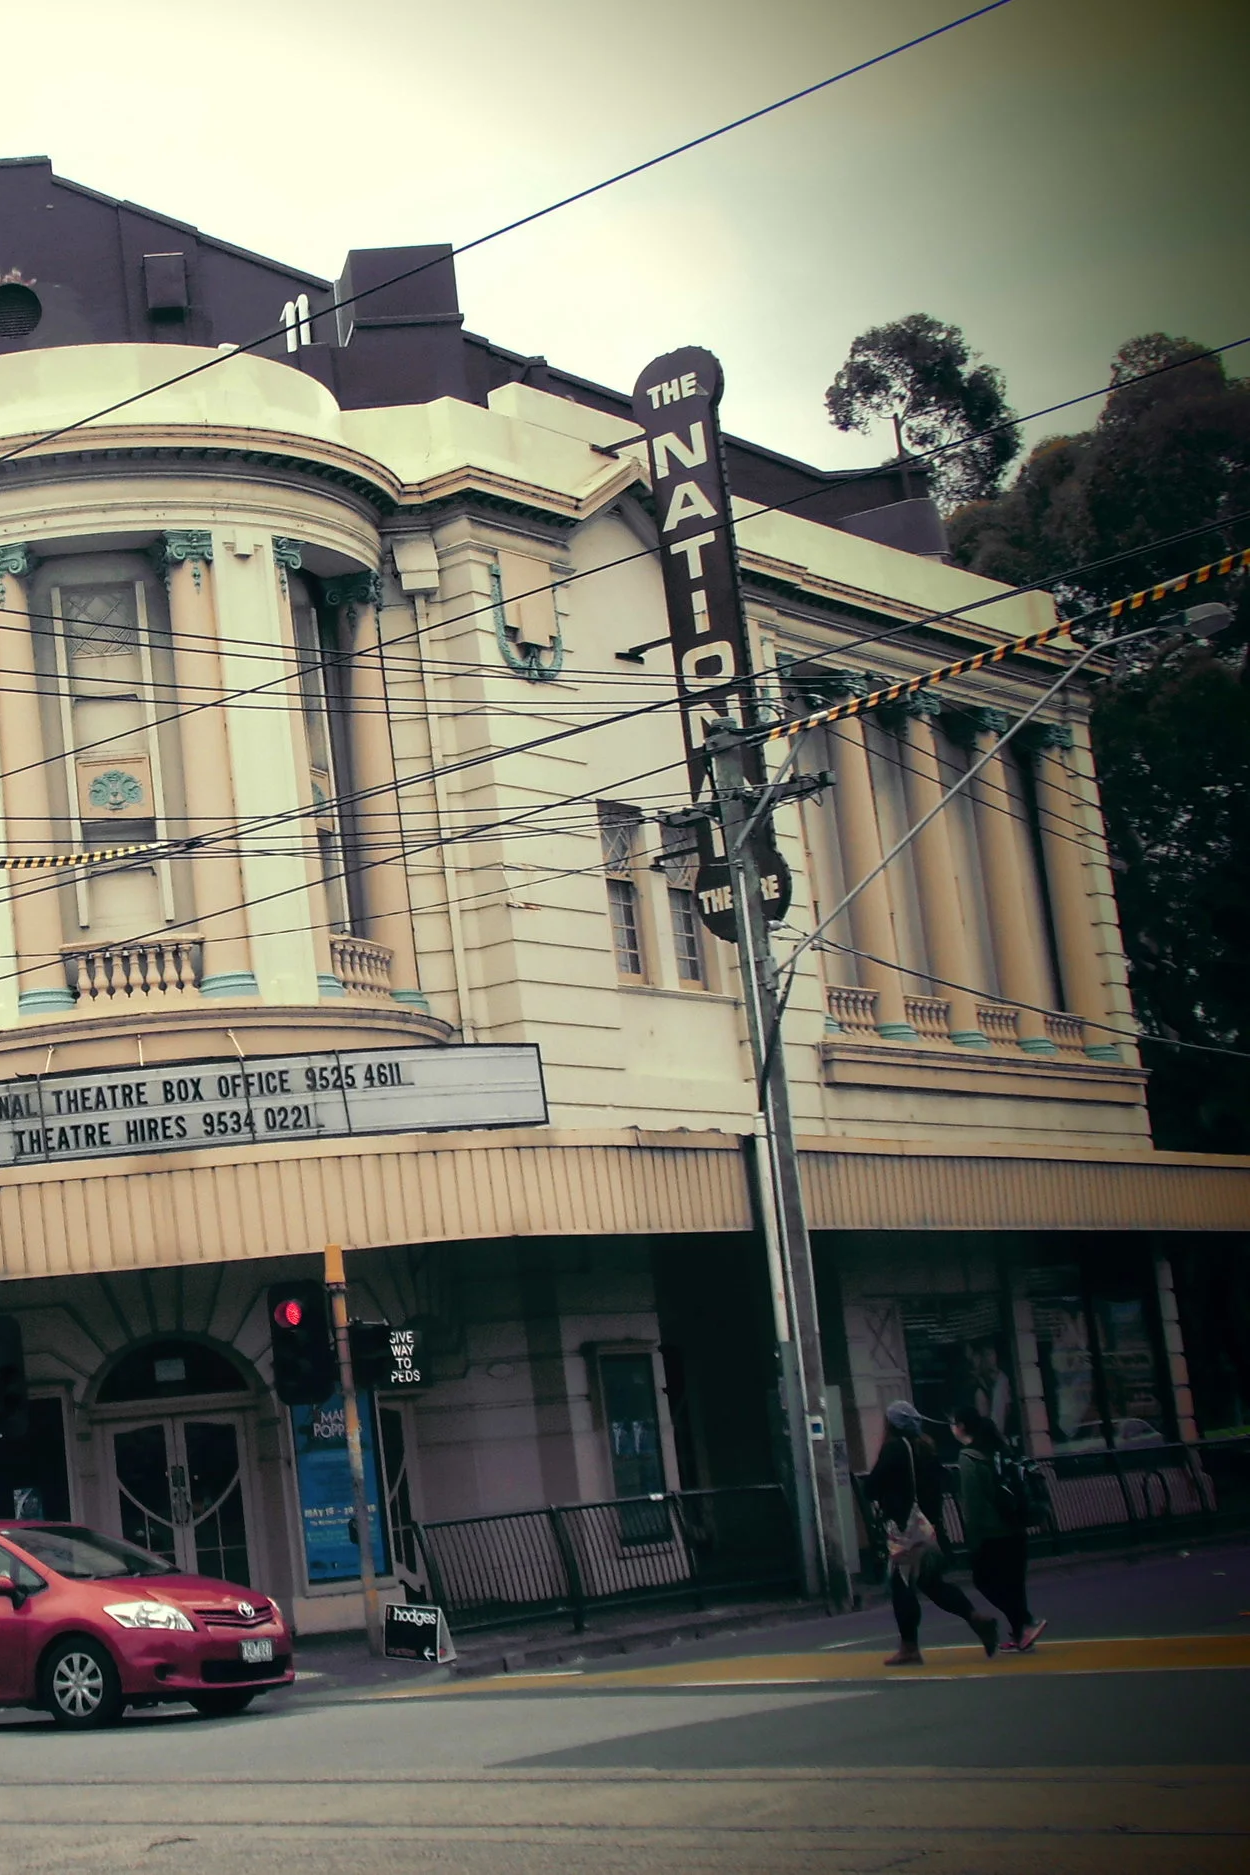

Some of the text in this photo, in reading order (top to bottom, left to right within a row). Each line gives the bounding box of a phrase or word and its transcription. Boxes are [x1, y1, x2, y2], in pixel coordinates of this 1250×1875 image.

[646, 371, 699, 410] THE
[697, 873, 781, 915] THERE
[52, 1082, 148, 1114] THEATRE
[162, 1077, 204, 1103] BOX
[217, 1070, 291, 1098] OFFICE
[305, 1064, 356, 1091] 9525
[364, 1062, 402, 1088] 4611
[15, 1104, 312, 1156] THEATRE HIRES 9534 0221
[388, 1330, 415, 1344] GIVE
[390, 1344, 414, 1356] WAY
[395, 1357, 412, 1369] TO
[390, 1369, 421, 1383] PEDS
[393, 1607, 437, 1627] hodges
